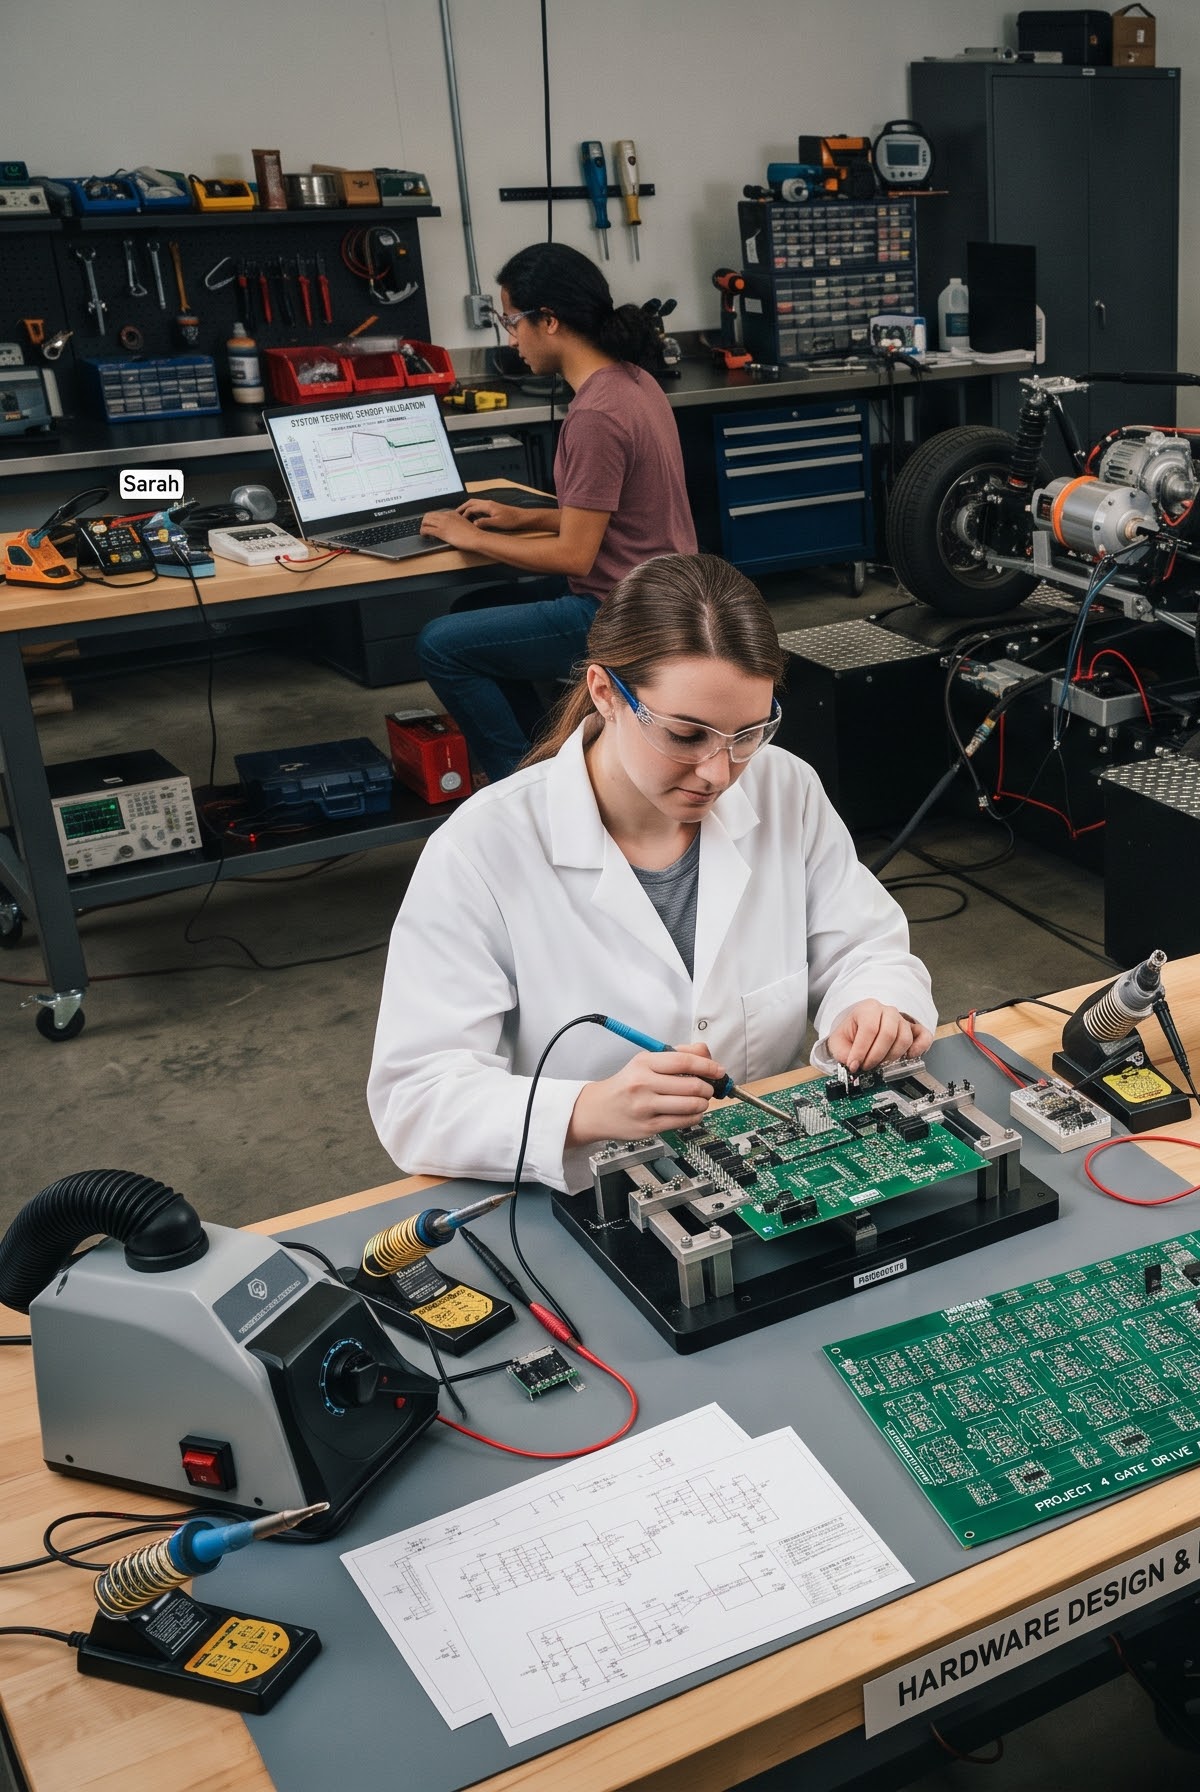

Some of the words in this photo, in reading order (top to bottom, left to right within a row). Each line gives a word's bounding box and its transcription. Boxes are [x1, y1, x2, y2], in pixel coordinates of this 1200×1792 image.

[1034, 1482, 1093, 1512] PROJECT
[1101, 1477, 1110, 1487] 4
[1114, 1462, 1148, 1481] GATE
[1151, 1445, 1193, 1467] DRIVE
[899, 1608, 1060, 1707] HARDWARE
[1068, 1563, 1165, 1625] DESIGN
[1174, 1549, 1191, 1575] &
